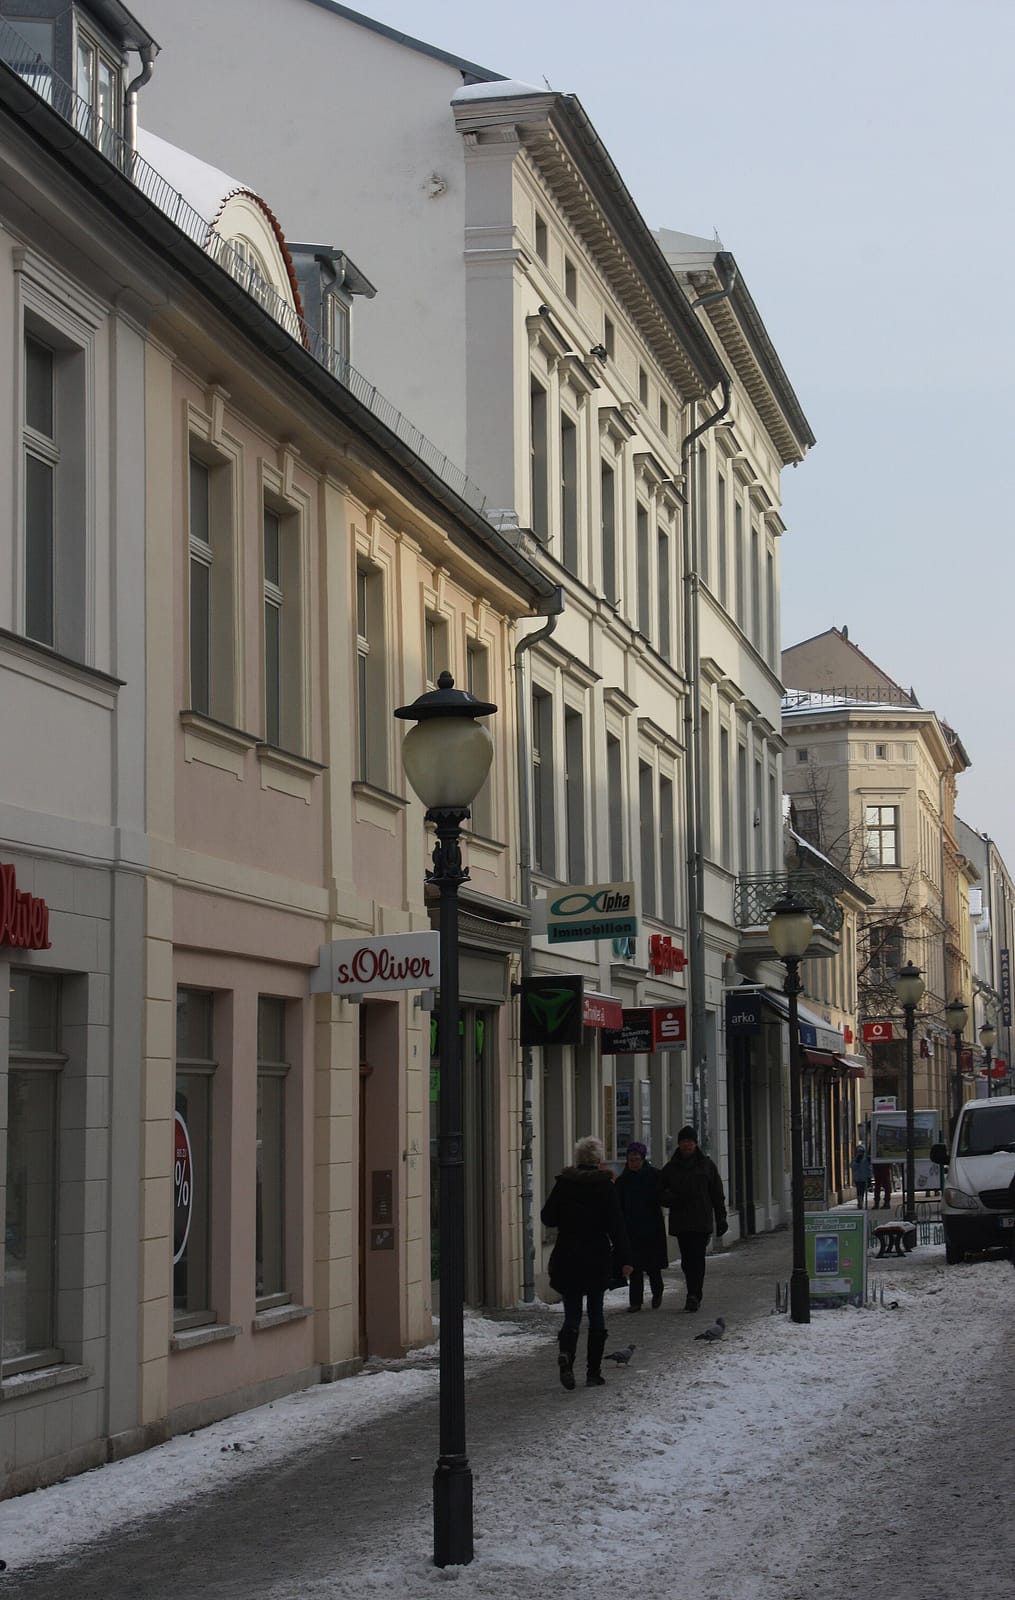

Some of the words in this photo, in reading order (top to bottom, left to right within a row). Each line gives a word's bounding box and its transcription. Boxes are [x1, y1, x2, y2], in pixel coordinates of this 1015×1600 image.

[552, 922, 632, 939] Immobilien
[337, 947, 434, 984] s.Oliver
[1001, 953, 1010, 1023] KARSTADT
[731, 1012, 755, 1024] arko
